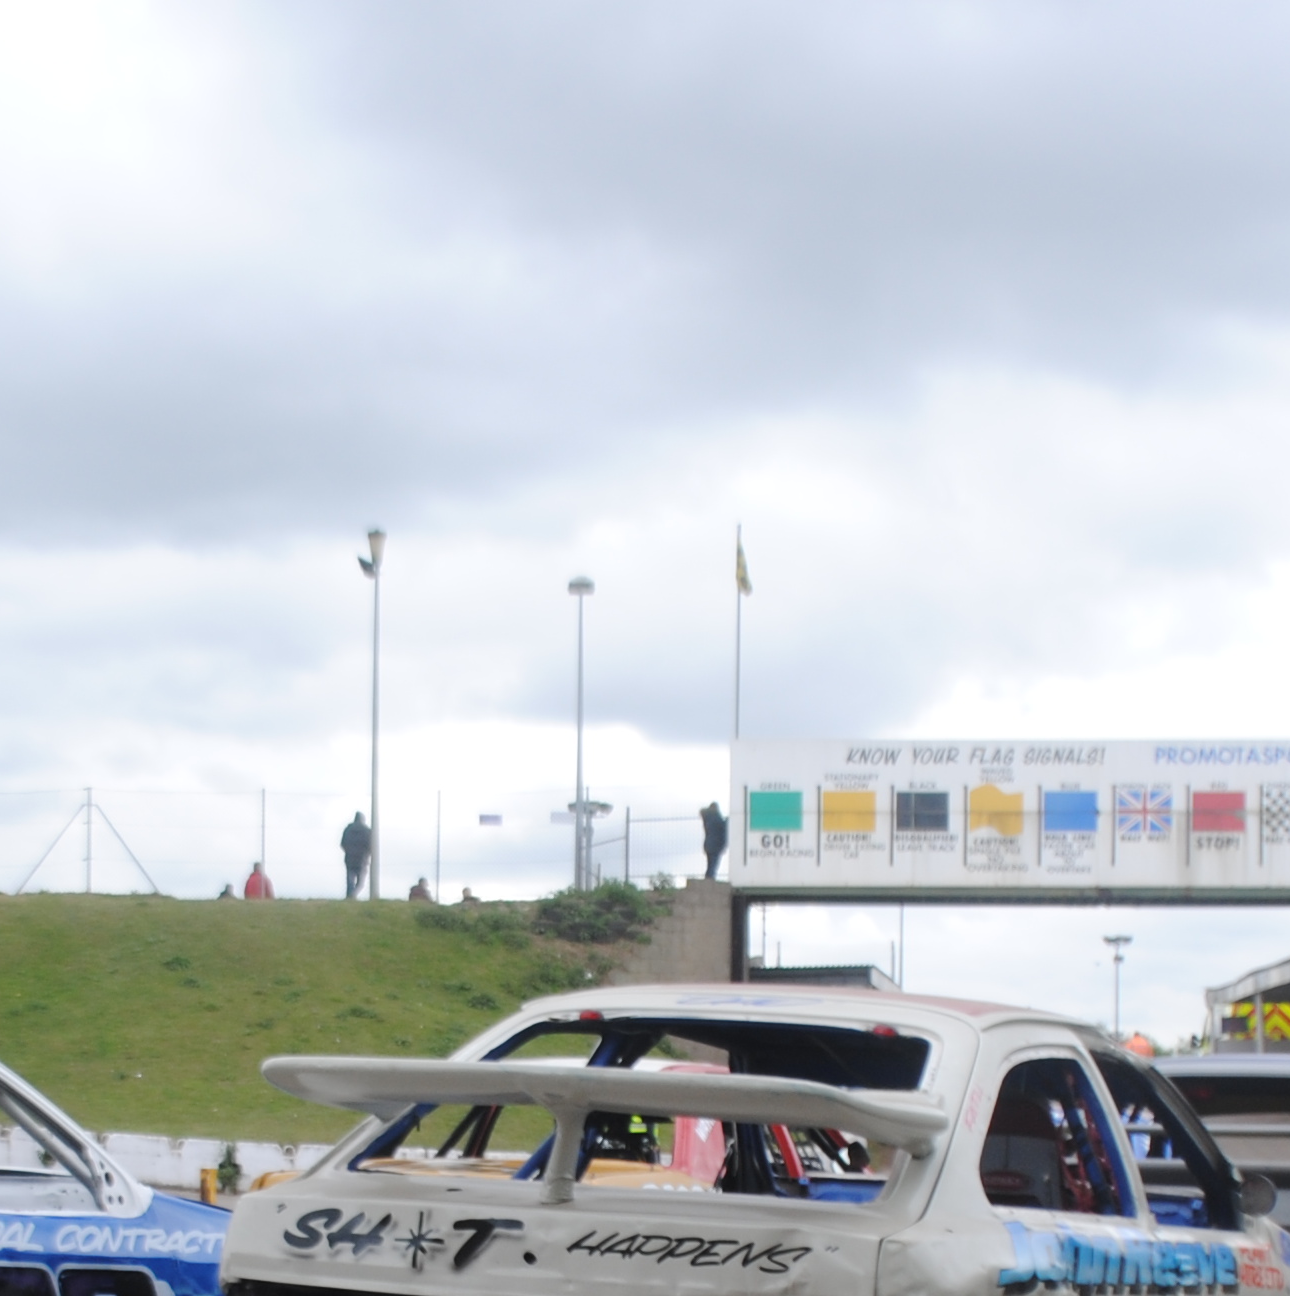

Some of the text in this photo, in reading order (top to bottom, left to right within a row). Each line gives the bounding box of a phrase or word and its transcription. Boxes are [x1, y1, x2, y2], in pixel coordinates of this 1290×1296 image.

[846, 746, 1106, 765] KNOW YOUR FLAG SIGNALS!
[760, 834, 791, 849] GO!
[826, 834, 872, 843] CAUTION!
[1195, 836, 1240, 850] STOP!
